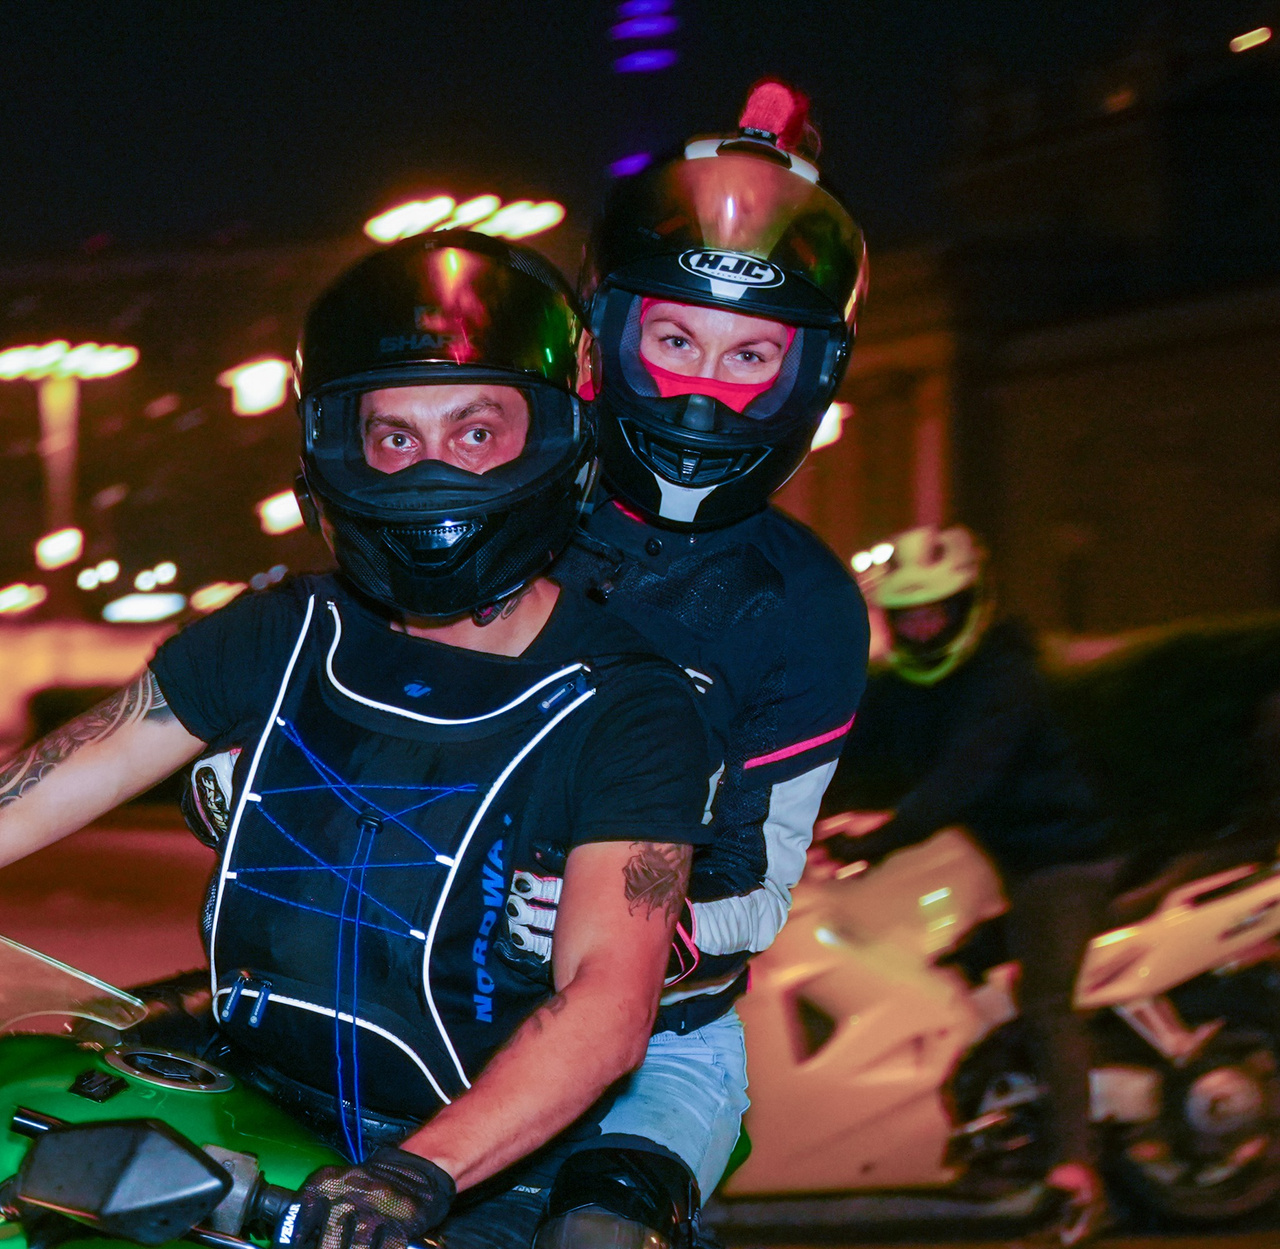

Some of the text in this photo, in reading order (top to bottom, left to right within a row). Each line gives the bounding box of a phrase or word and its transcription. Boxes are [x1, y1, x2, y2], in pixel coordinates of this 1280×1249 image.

[695, 253, 770, 280] HJC
[381, 333, 477, 353] SHAR
[279, 1203, 302, 1244] VEMAR
